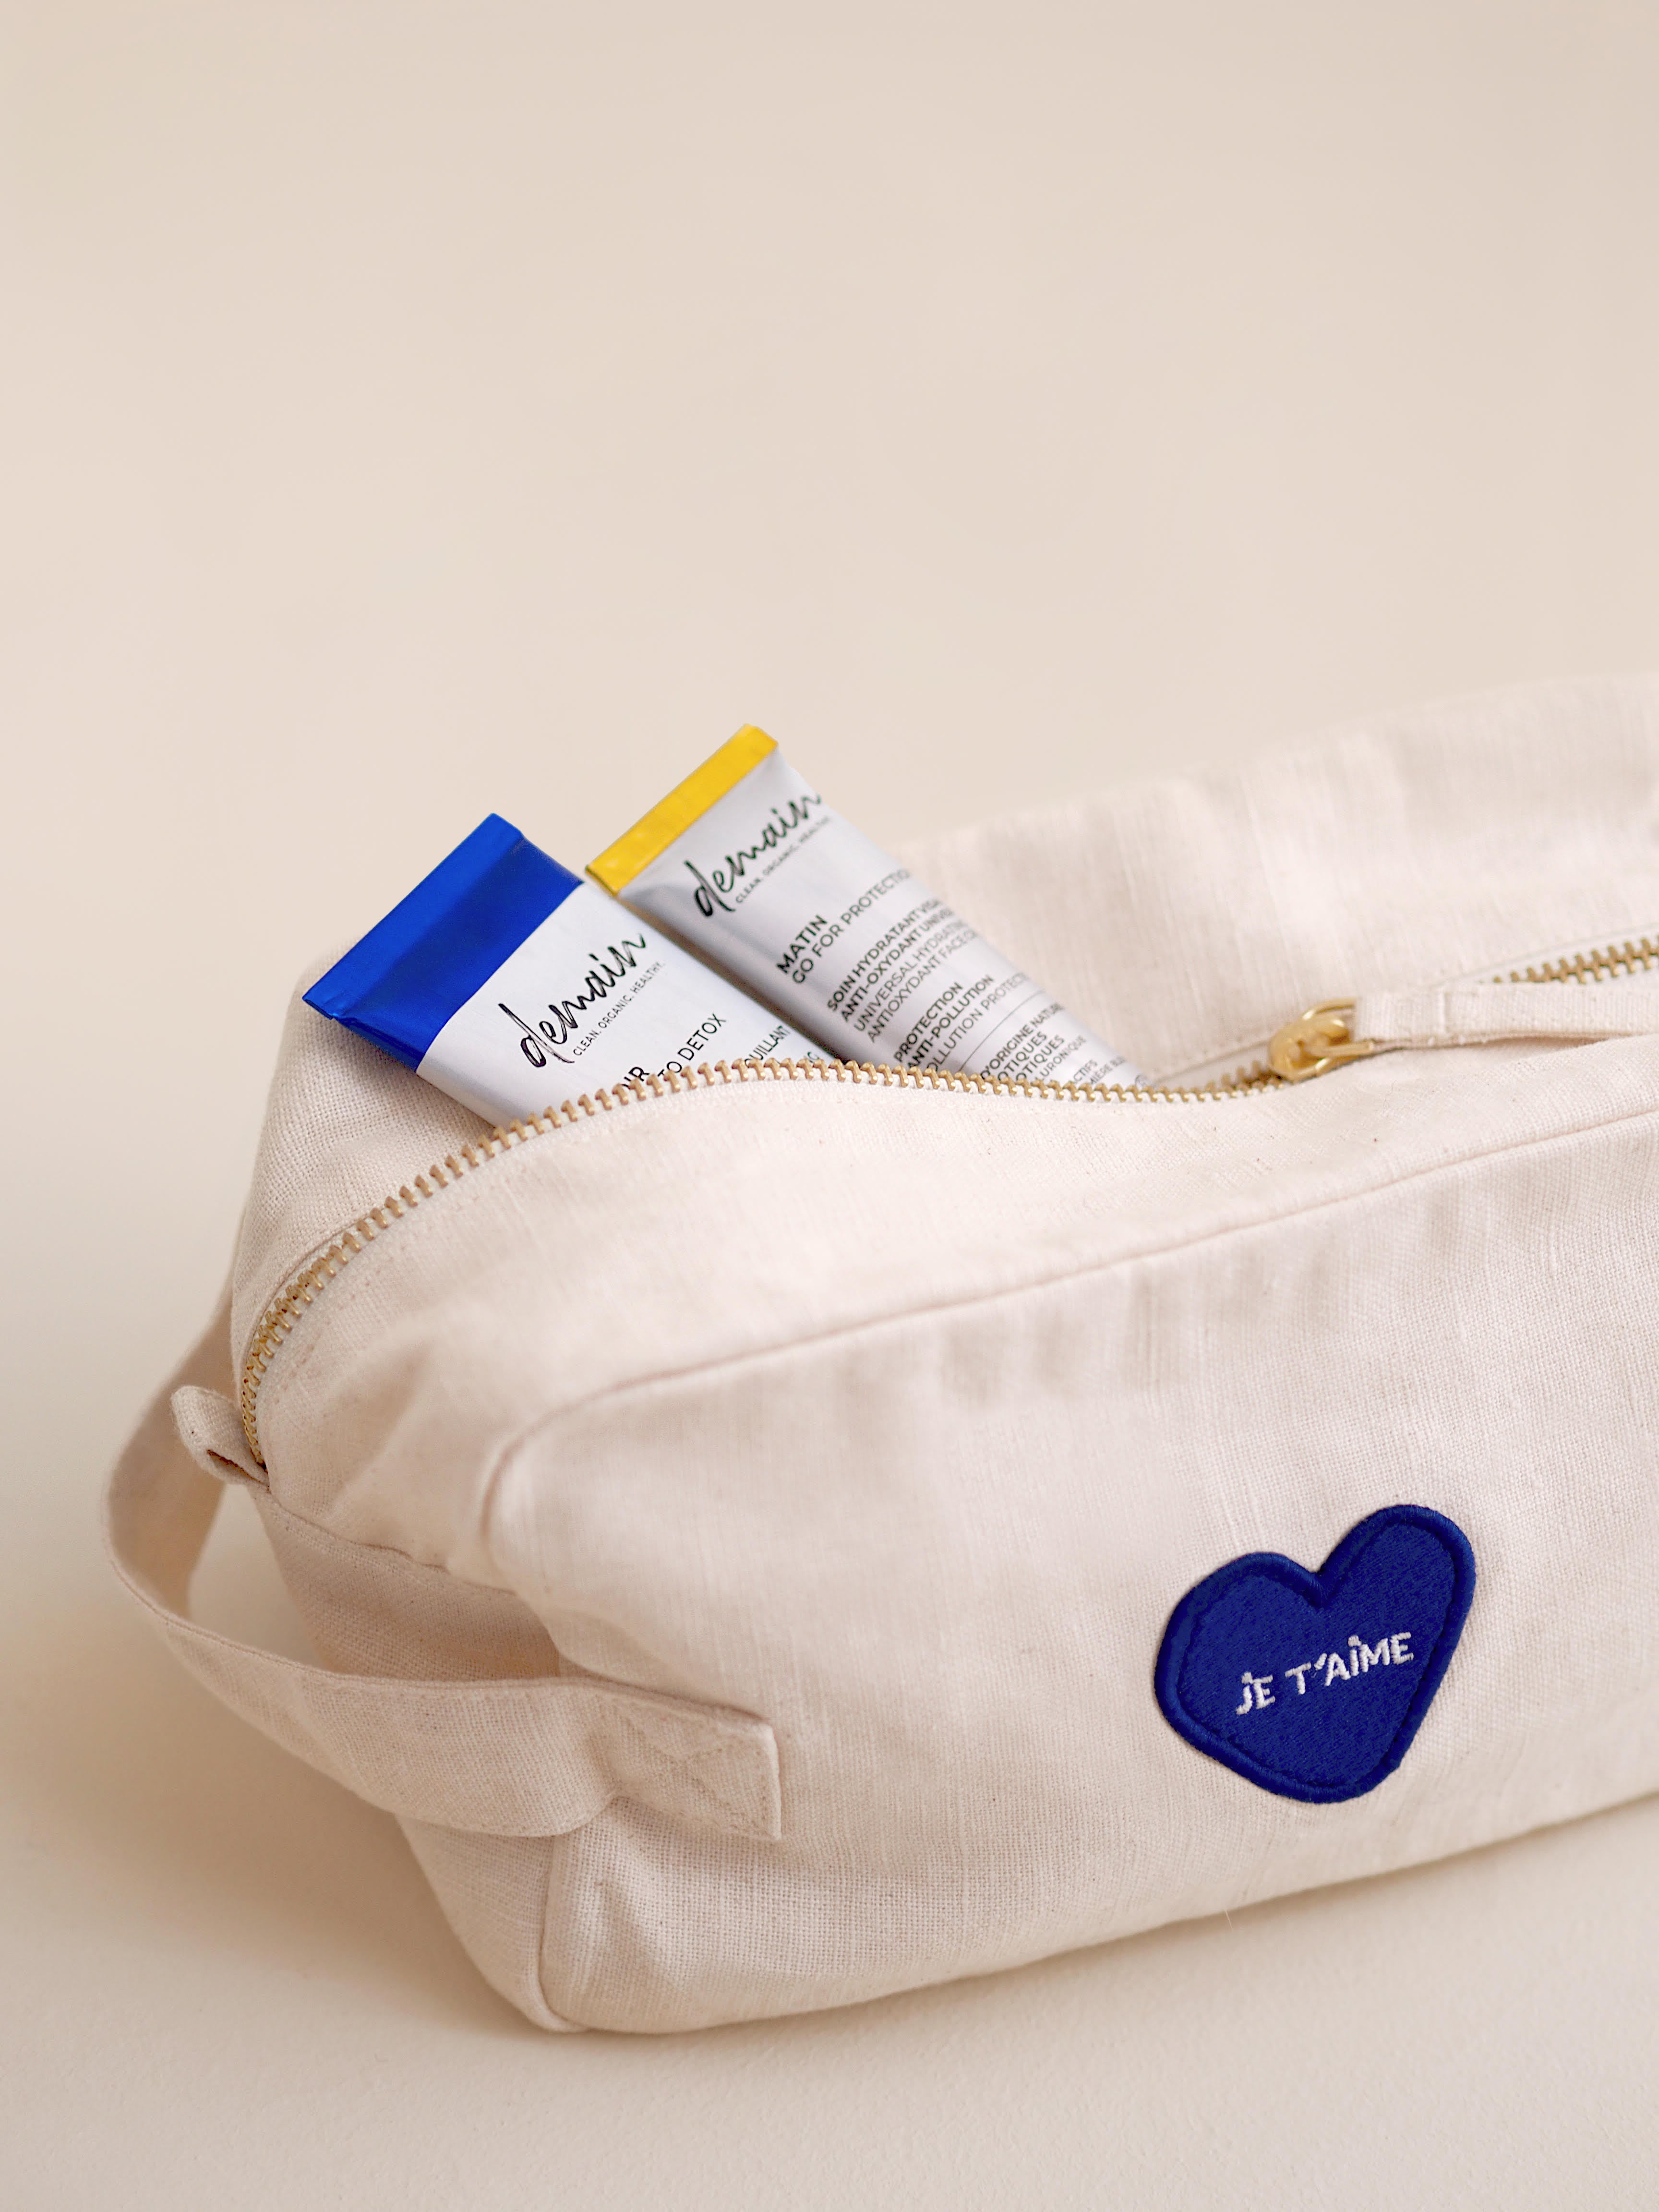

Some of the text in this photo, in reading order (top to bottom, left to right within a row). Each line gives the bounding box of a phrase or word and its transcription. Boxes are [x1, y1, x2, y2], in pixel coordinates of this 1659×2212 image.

[684, 794, 822, 917] demain
[776, 914, 828, 974] MATIN
[793, 958, 814, 984] GO
[811, 924, 844, 958] FOR
[827, 975, 856, 1012] SOIN
[852, 910, 920, 977] HYDRATANT
[841, 928, 922, 1022] ANTI-OXYDANT
[498, 933, 647, 1068] demain
[573, 961, 665, 1056] CLEAN. ORGANIC. HEALTHY.
[854, 961, 918, 1032] UNIVERSAL
[867, 955, 941, 1043] ANTIOXYDANT
[893, 982, 963, 1063] PROTECTION
[908, 974, 994, 1069] ANTI-POLLUTION
[677, 1013, 726, 1061] DETOX
[927, 1008, 983, 1072] OLLUTION
[998, 1031, 1047, 1081] OTIQUES
[1016, 1034, 1065, 1081] OTIQUES
[1070, 1059, 1098, 1084] CTIFS
